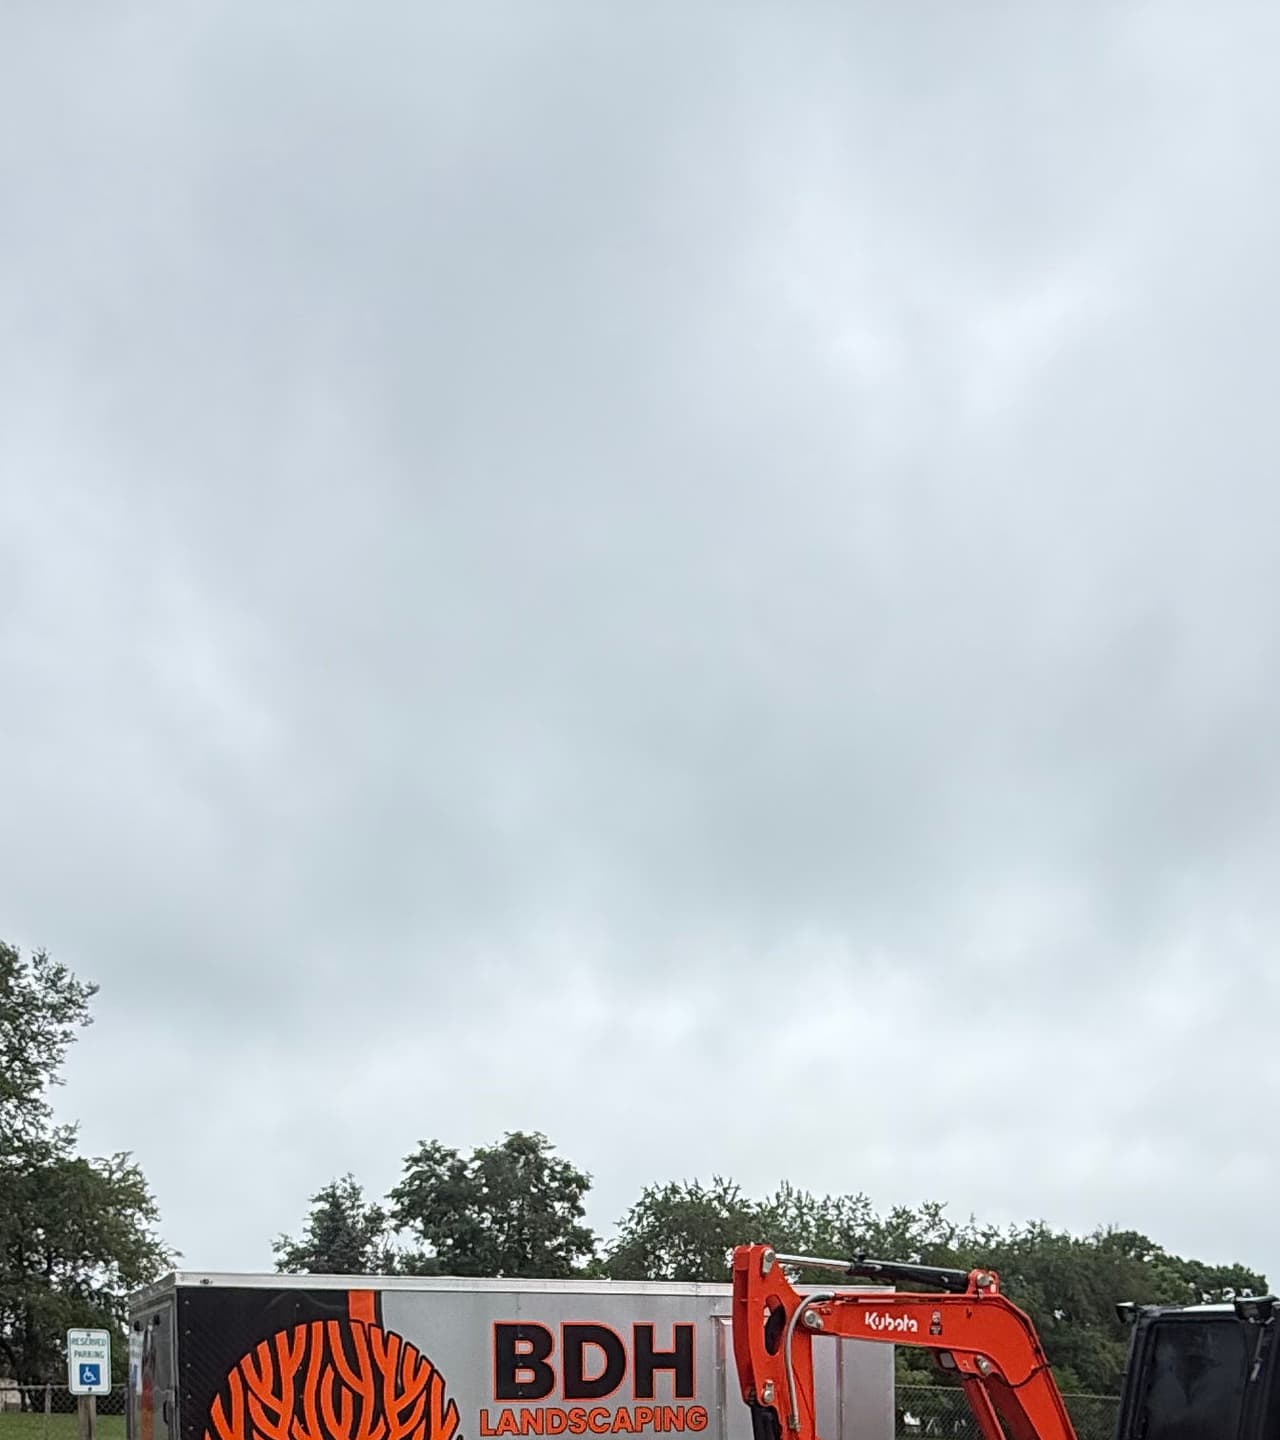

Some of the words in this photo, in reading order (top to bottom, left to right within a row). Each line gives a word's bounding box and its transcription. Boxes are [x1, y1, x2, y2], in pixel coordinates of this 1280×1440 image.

[865, 1312, 918, 1332] Kubota
[494, 1321, 696, 1401] BDH
[480, 1406, 708, 1436] LANDSCAPING
